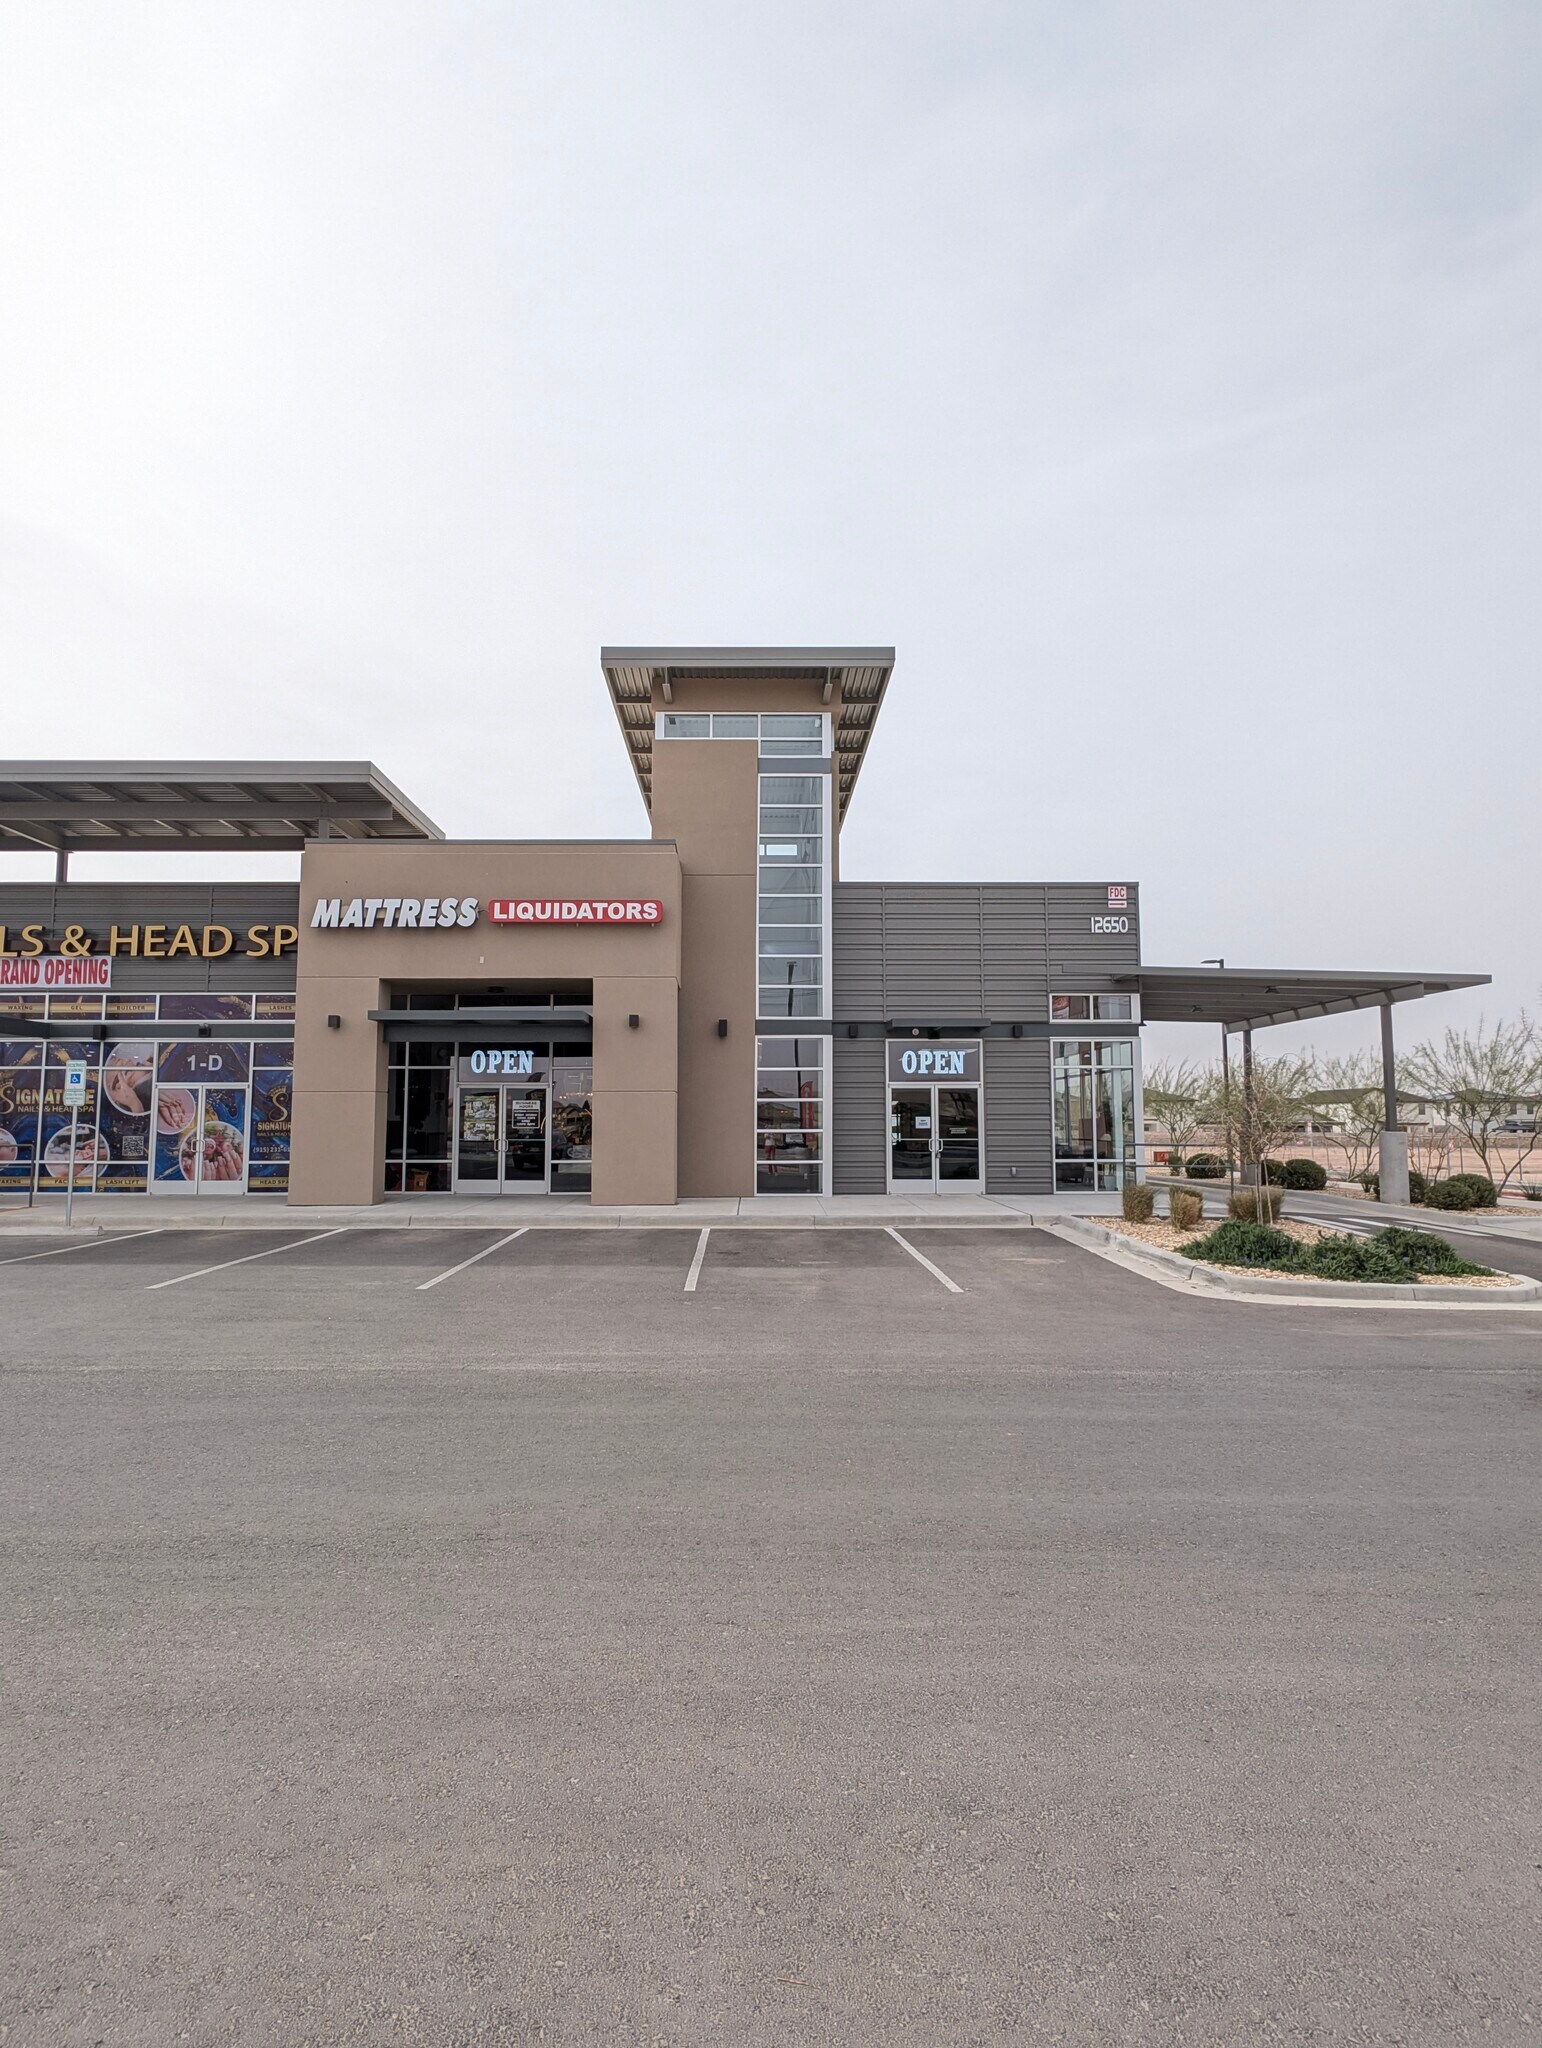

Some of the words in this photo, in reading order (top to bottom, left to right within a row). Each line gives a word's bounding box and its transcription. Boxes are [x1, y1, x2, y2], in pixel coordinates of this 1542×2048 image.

[1110, 888, 1125, 897] FDC
[310, 898, 479, 928] MATTRESS
[493, 902, 658, 920] LIQUIDATORS
[1091, 917, 1128, 933] 12650
[0, 924, 44, 957] LS
[60, 924, 92, 957] &
[109, 924, 233, 957] HEAD
[246, 924, 298, 957] SP
[0, 959, 40, 985] RAND
[44, 959, 109, 985] OPENING
[187, 1054, 223, 1071] 1-D
[471, 1050, 534, 1073] OPEN
[902, 1050, 965, 1074] OPEN
[0, 1085, 95, 1114] SIGNATE
[17, 1105, 40, 1113] NAILS
[253, 1146, 270, 1154] (915)
